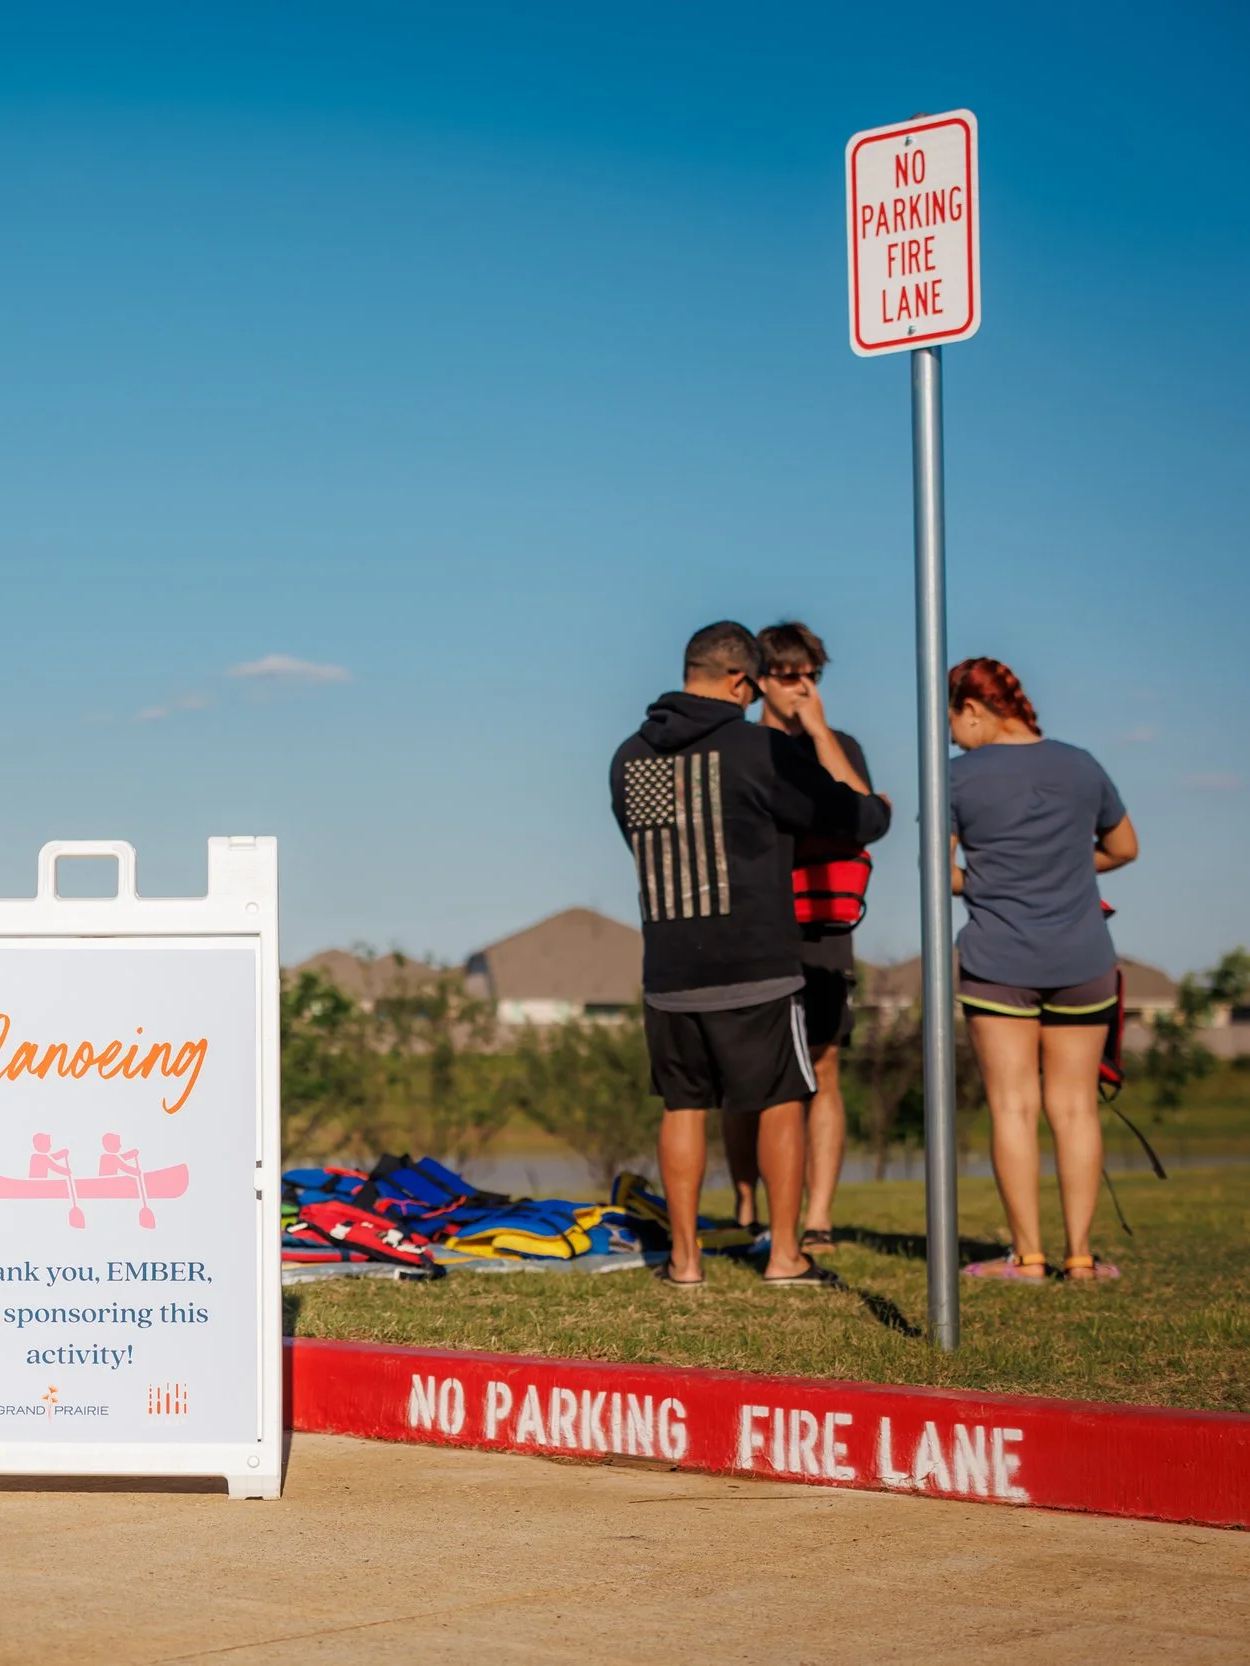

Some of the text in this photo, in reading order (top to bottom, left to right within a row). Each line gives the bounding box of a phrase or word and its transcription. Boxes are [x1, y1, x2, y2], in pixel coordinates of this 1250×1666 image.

[895, 149, 926, 189] NO
[861, 186, 963, 240] PARKING
[887, 235, 937, 278] FIRE
[882, 278, 944, 324] LANE
[46, 1266, 101, 1287] you,
[106, 1261, 213, 1284] EMBER,
[3, 1302, 154, 1329] sponsoring
[160, 1302, 209, 1323] this
[26, 1343, 134, 1370] activity!
[54, 1405, 110, 1416] PRAIRIE
[408, 1373, 1030, 1503] NO PARKING FIRE LANE
